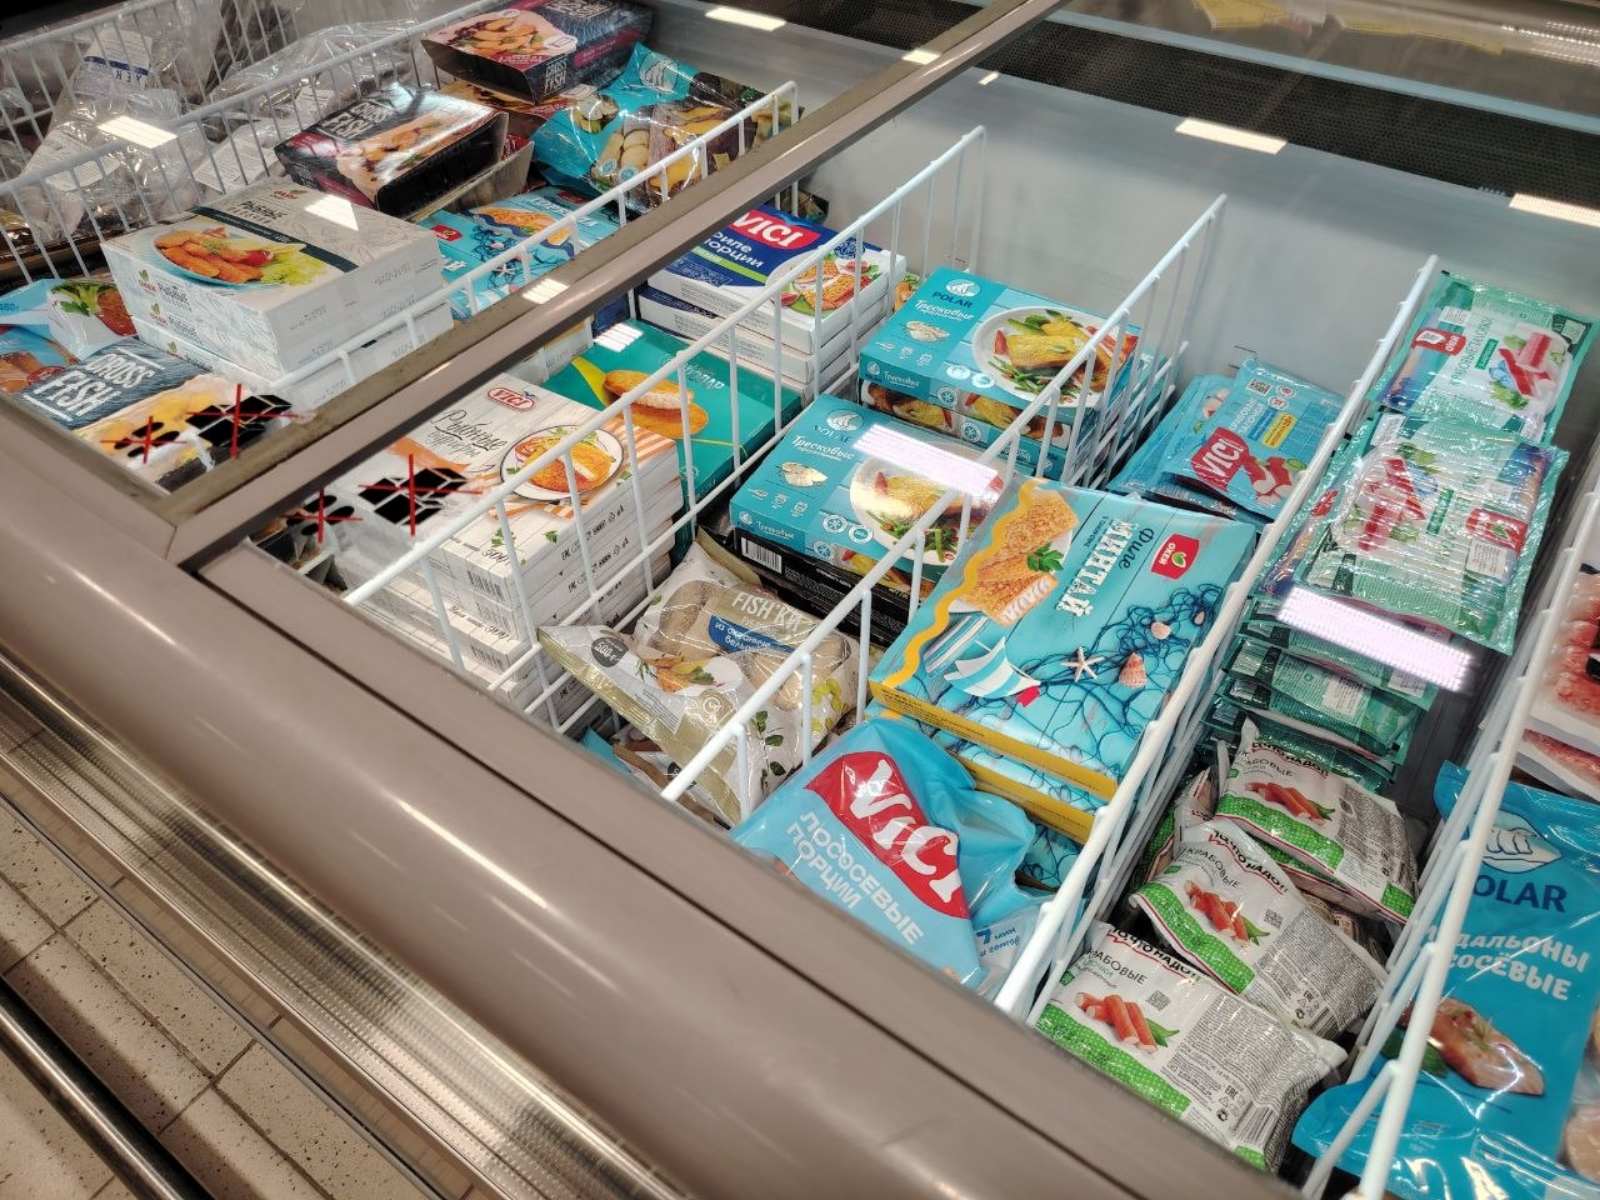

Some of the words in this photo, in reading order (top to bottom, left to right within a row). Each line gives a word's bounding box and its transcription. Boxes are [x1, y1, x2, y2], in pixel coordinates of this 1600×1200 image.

[734, 212, 804, 247] VICI
[932, 291, 973, 308] POLAR
[85, 353, 155, 388] CROSS
[34, 370, 122, 416] FISH
[1202, 438, 1244, 477] VICI
[1056, 518, 1139, 617] МИНТАЙ
[1118, 527, 1155, 570] Филе
[850, 759, 961, 903] VICI
[786, 821, 862, 909] ПОРЦИИ
[799, 811, 925, 945] ЛОСОСЕВЫЕ
[1473, 874, 1568, 912] OLAR
[976, 928, 992, 945] 7
[1455, 932, 1591, 973] ДАЛЬОНЫ
